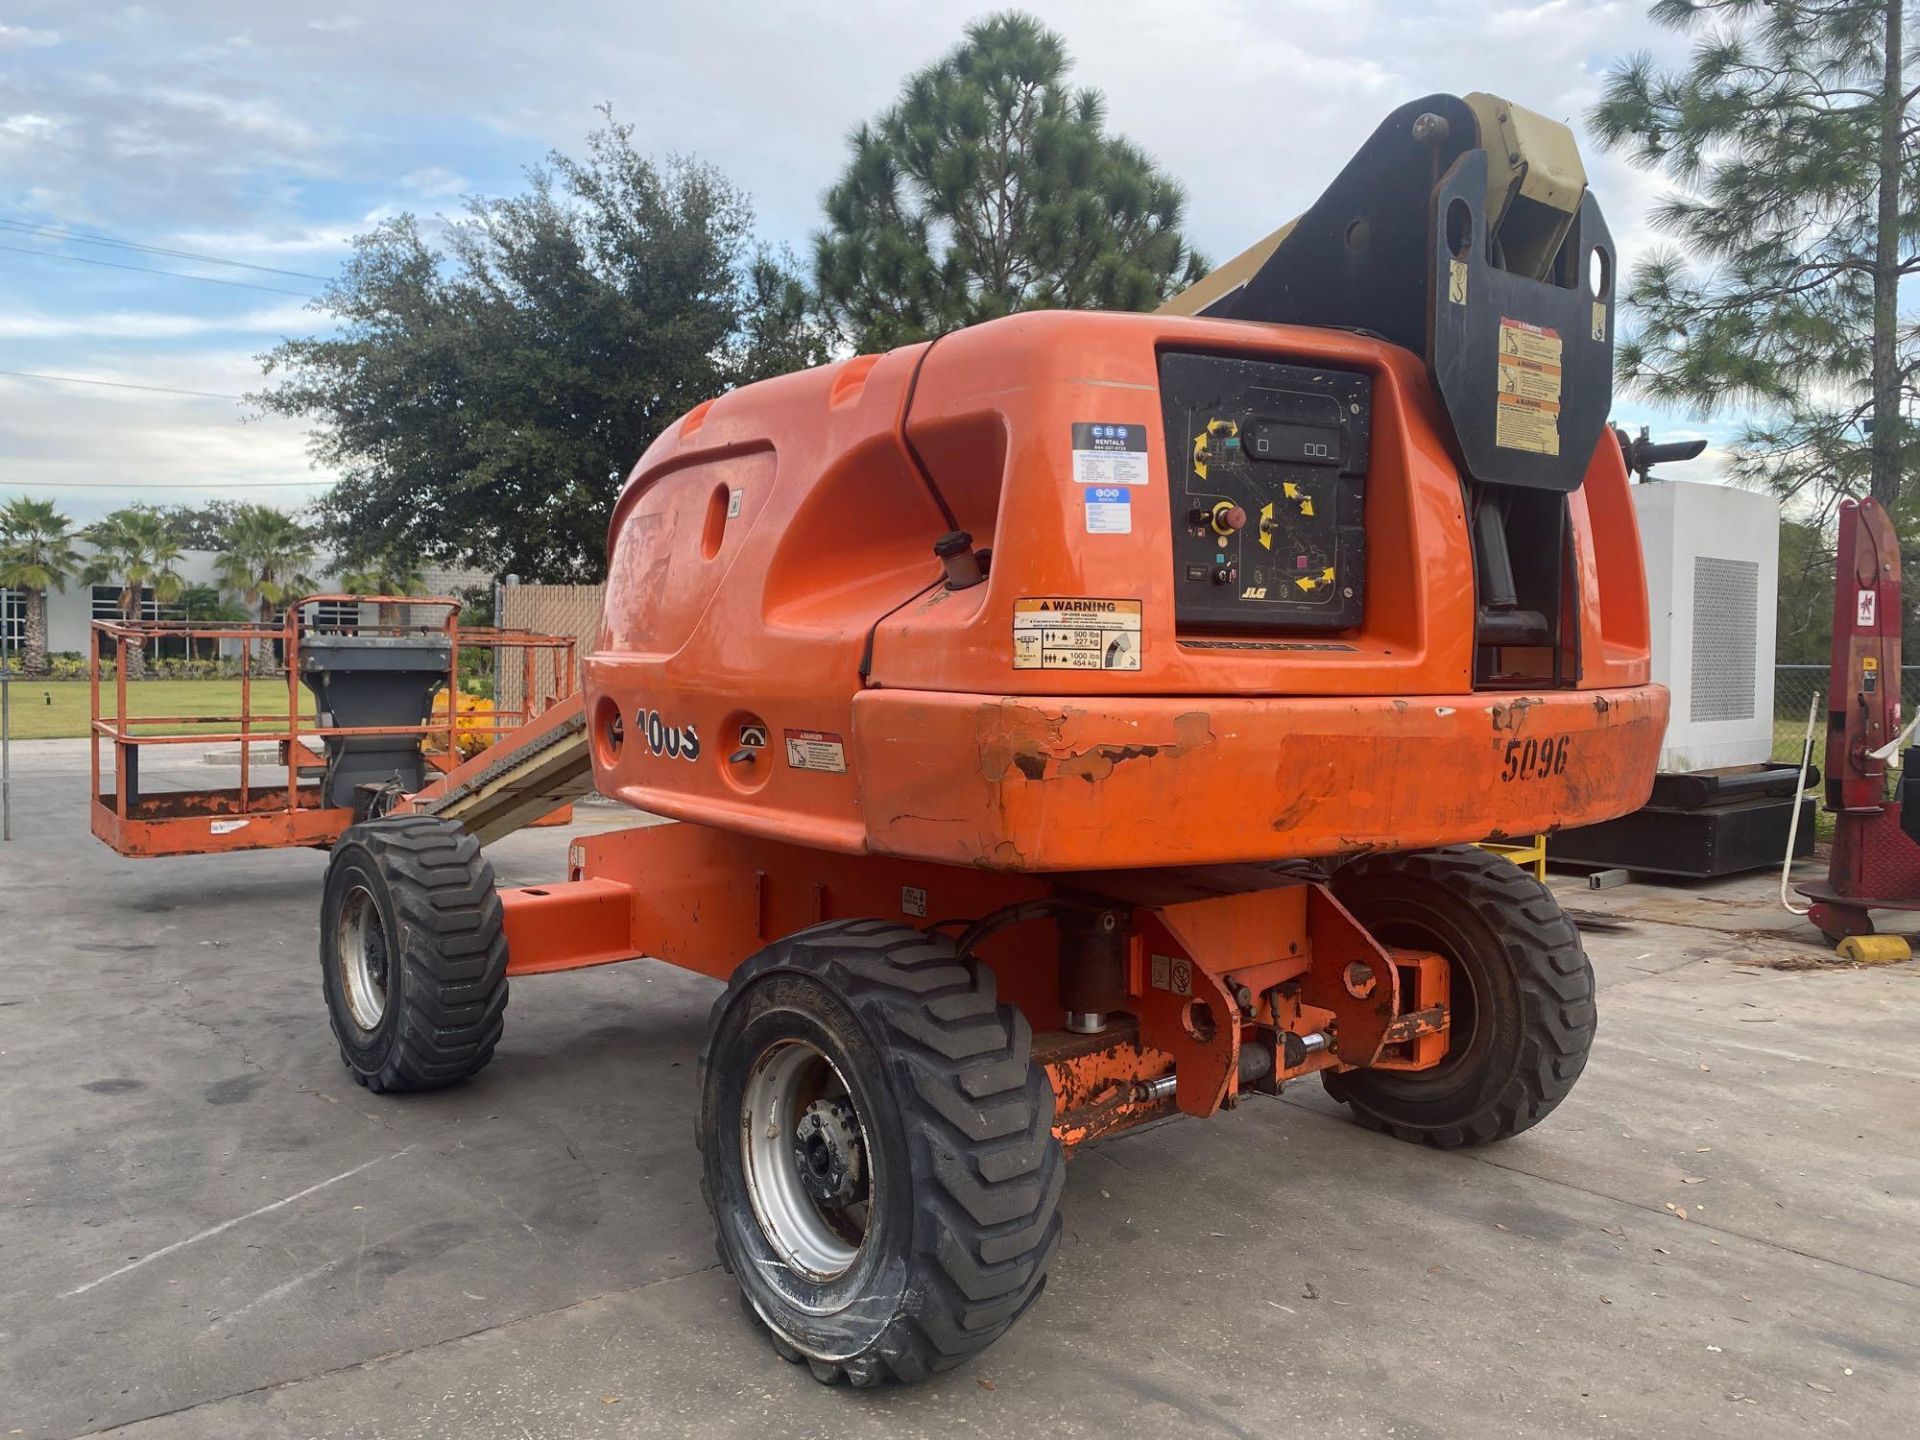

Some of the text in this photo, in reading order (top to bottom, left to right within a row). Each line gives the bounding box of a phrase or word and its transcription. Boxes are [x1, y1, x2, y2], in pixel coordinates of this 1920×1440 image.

[1241, 587, 1267, 599] JLG
[1053, 601, 1116, 612] WARNING
[1090, 639, 1099, 647] kg
[1088, 660, 1097, 668] kg
[1502, 736, 1570, 782] 5096
